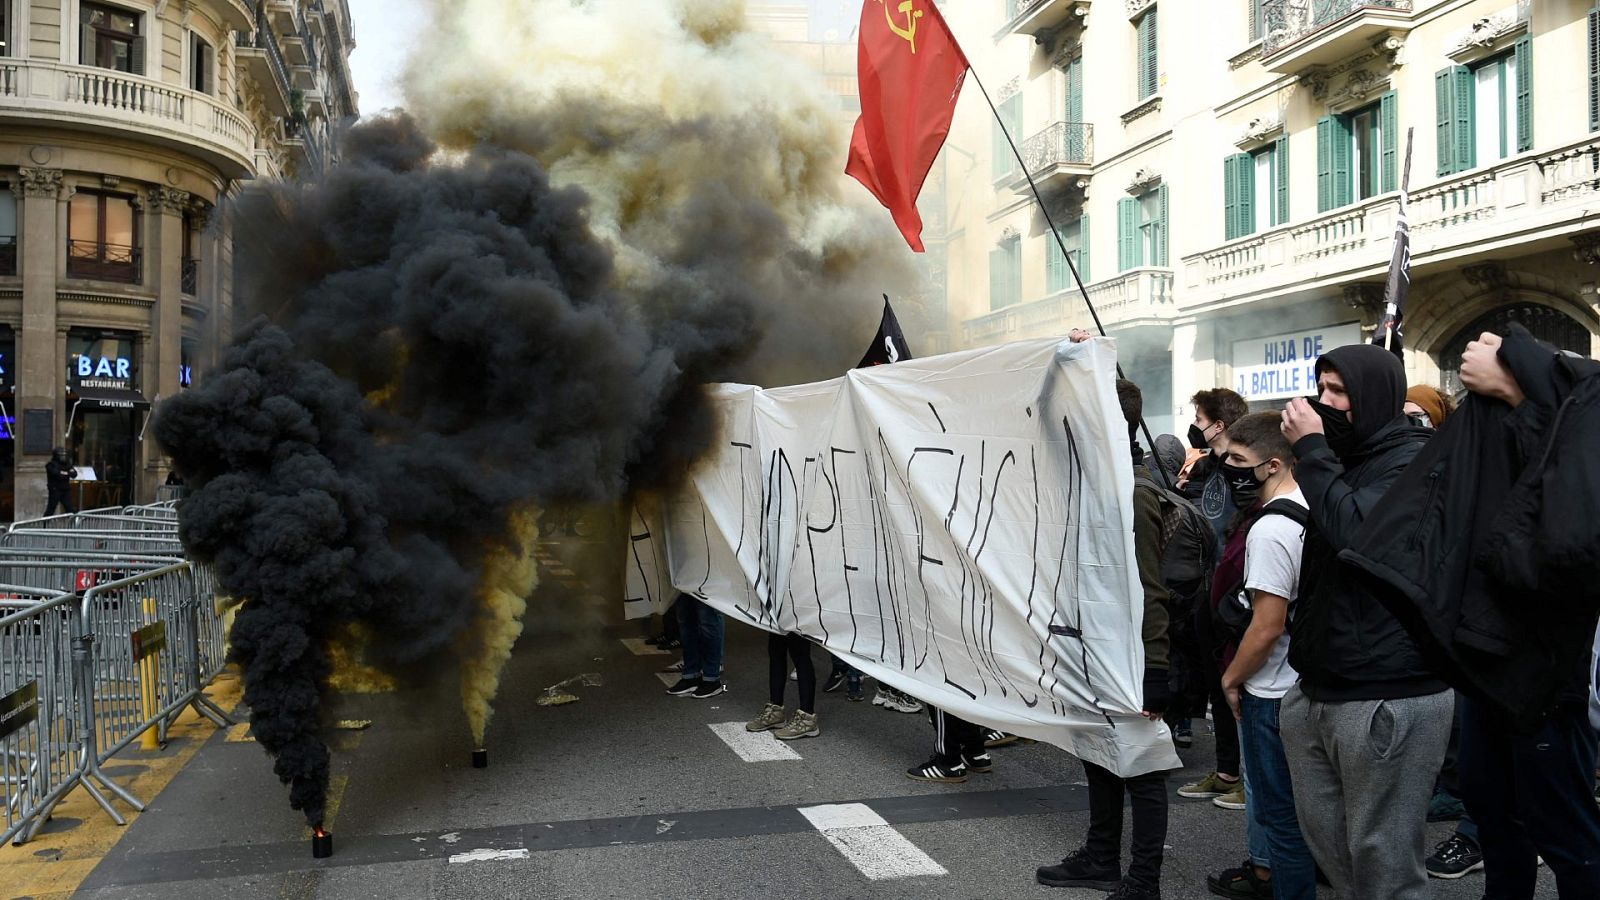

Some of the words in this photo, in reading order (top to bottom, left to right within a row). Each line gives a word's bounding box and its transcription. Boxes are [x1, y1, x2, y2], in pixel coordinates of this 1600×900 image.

[1265, 339, 1296, 365] HIJA
[1304, 335, 1323, 360] DE
[78, 355, 130, 378] BAR
[80, 380, 126, 389] RESTAURANT
[1237, 375, 1248, 395] J.
[1252, 368, 1299, 394] BATLLE
